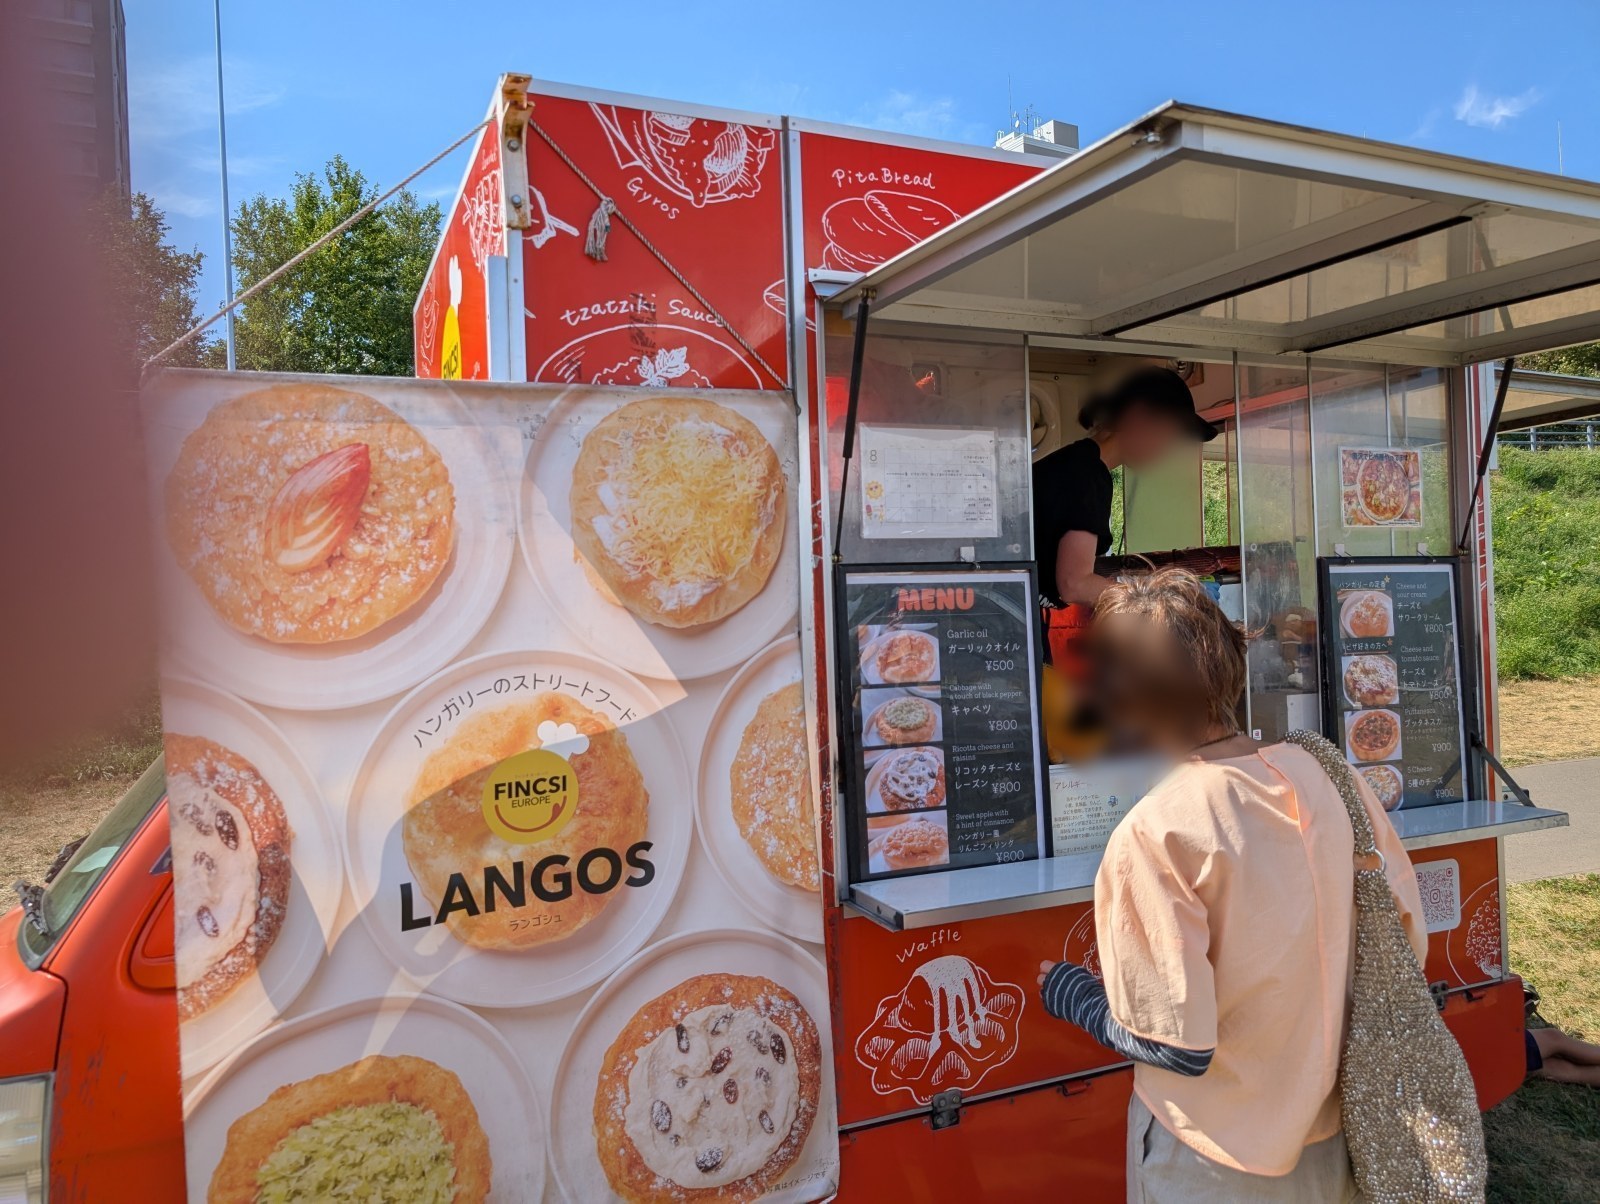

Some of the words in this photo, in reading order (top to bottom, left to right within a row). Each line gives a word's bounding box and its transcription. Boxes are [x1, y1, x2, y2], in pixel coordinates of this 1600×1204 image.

[881, 167, 936, 189] Bread
[627, 177, 680, 220] Gyros
[869, 450, 878, 462] 8
[897, 587, 975, 611] MENU
[1398, 614, 1440, 622] サワークリーム
[947, 629, 975, 639] Garlic
[976, 629, 989, 638] oil
[949, 643, 1021, 654] ガーリックオイル
[985, 660, 1014, 671] ¥500
[949, 684, 976, 693] Cabbage
[978, 683, 992, 691] with
[955, 692, 973, 700] touch
[981, 691, 999, 699] black
[1000, 690, 1023, 699] pepper
[413, 672, 638, 749] ハンガリーのストリートフード
[952, 704, 991, 716] キャベツ
[988, 719, 1018, 731] ¥800
[952, 745, 976, 753] Ricotta
[977, 743, 1000, 751] cheese
[1002, 742, 1014, 750] and
[953, 754, 976, 762] raisins
[955, 762, 1022, 776] リコッタチーズと
[494, 775, 567, 800] FINCSI
[955, 778, 989, 790] レーズン
[991, 781, 1021, 794] ¥800
[511, 795, 551, 808] EUROPE
[955, 813, 975, 821] Sweet
[961, 821, 975, 829] hint
[996, 850, 1025, 863] ¥800
[400, 841, 656, 932] LANGOS
[509, 914, 563, 932] ランゴシュ
